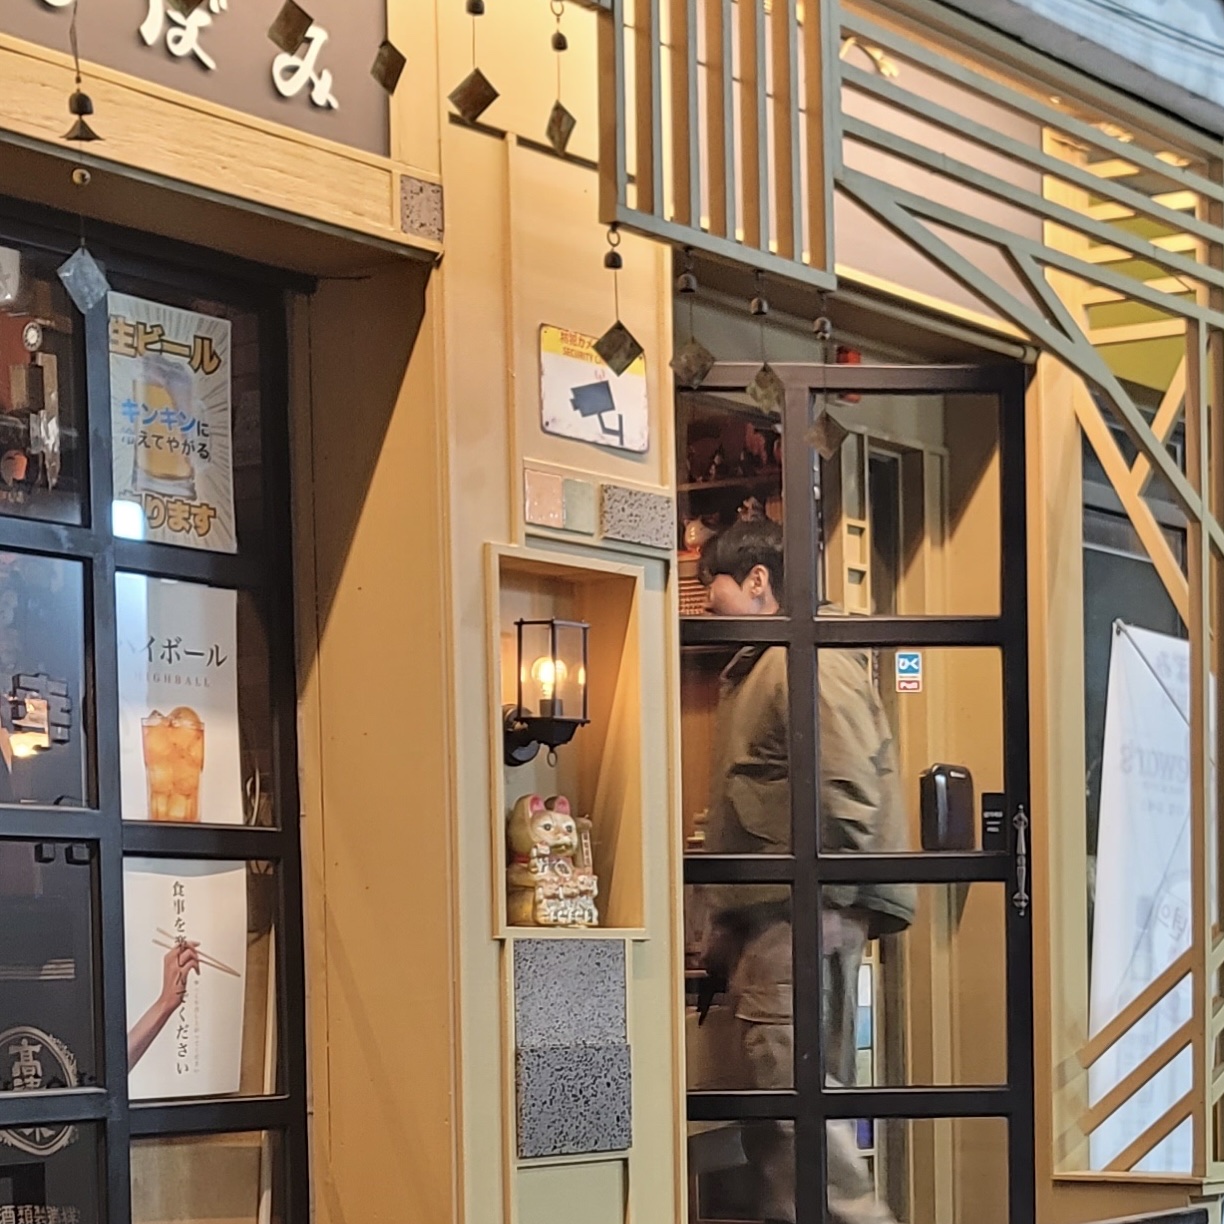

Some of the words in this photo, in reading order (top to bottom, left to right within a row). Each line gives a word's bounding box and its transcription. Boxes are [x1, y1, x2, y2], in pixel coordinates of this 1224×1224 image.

[109, 314, 222, 376] 生ビール
[121, 398, 211, 438] キンキンに
[118, 489, 218, 538] ります
